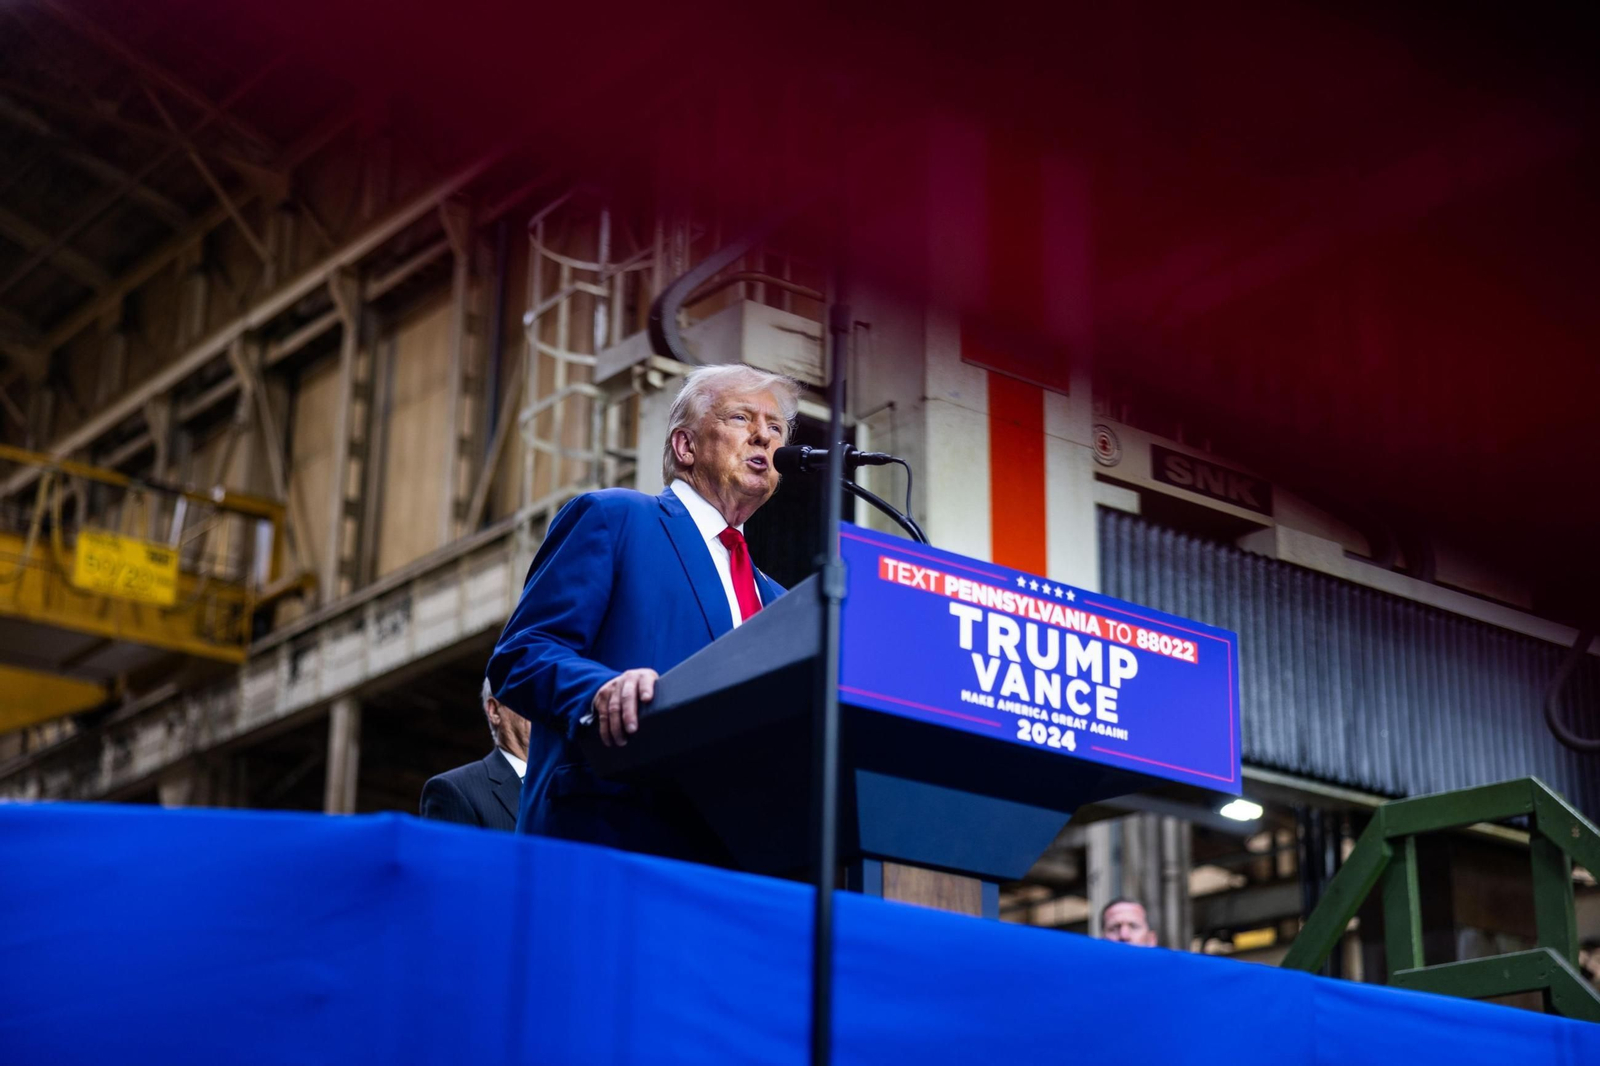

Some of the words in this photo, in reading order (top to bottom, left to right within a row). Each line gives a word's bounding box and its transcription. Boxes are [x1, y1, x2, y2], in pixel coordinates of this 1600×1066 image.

[1163, 455, 1260, 508] SNK
[883, 557, 939, 591] TEXT
[944, 575, 1101, 637] PENNSYLVANIA
[1105, 618, 1132, 644] TO
[1136, 628, 1195, 662] 88022
[949, 601, 1139, 689] TRUMP
[960, 689, 995, 708] MAKE
[996, 699, 1049, 721] AMERICA
[1051, 712, 1088, 731] GREAT
[1089, 721, 1128, 740] AGAIN!
[971, 652, 1118, 724] VANCE
[1016, 719, 1077, 752] 2024
